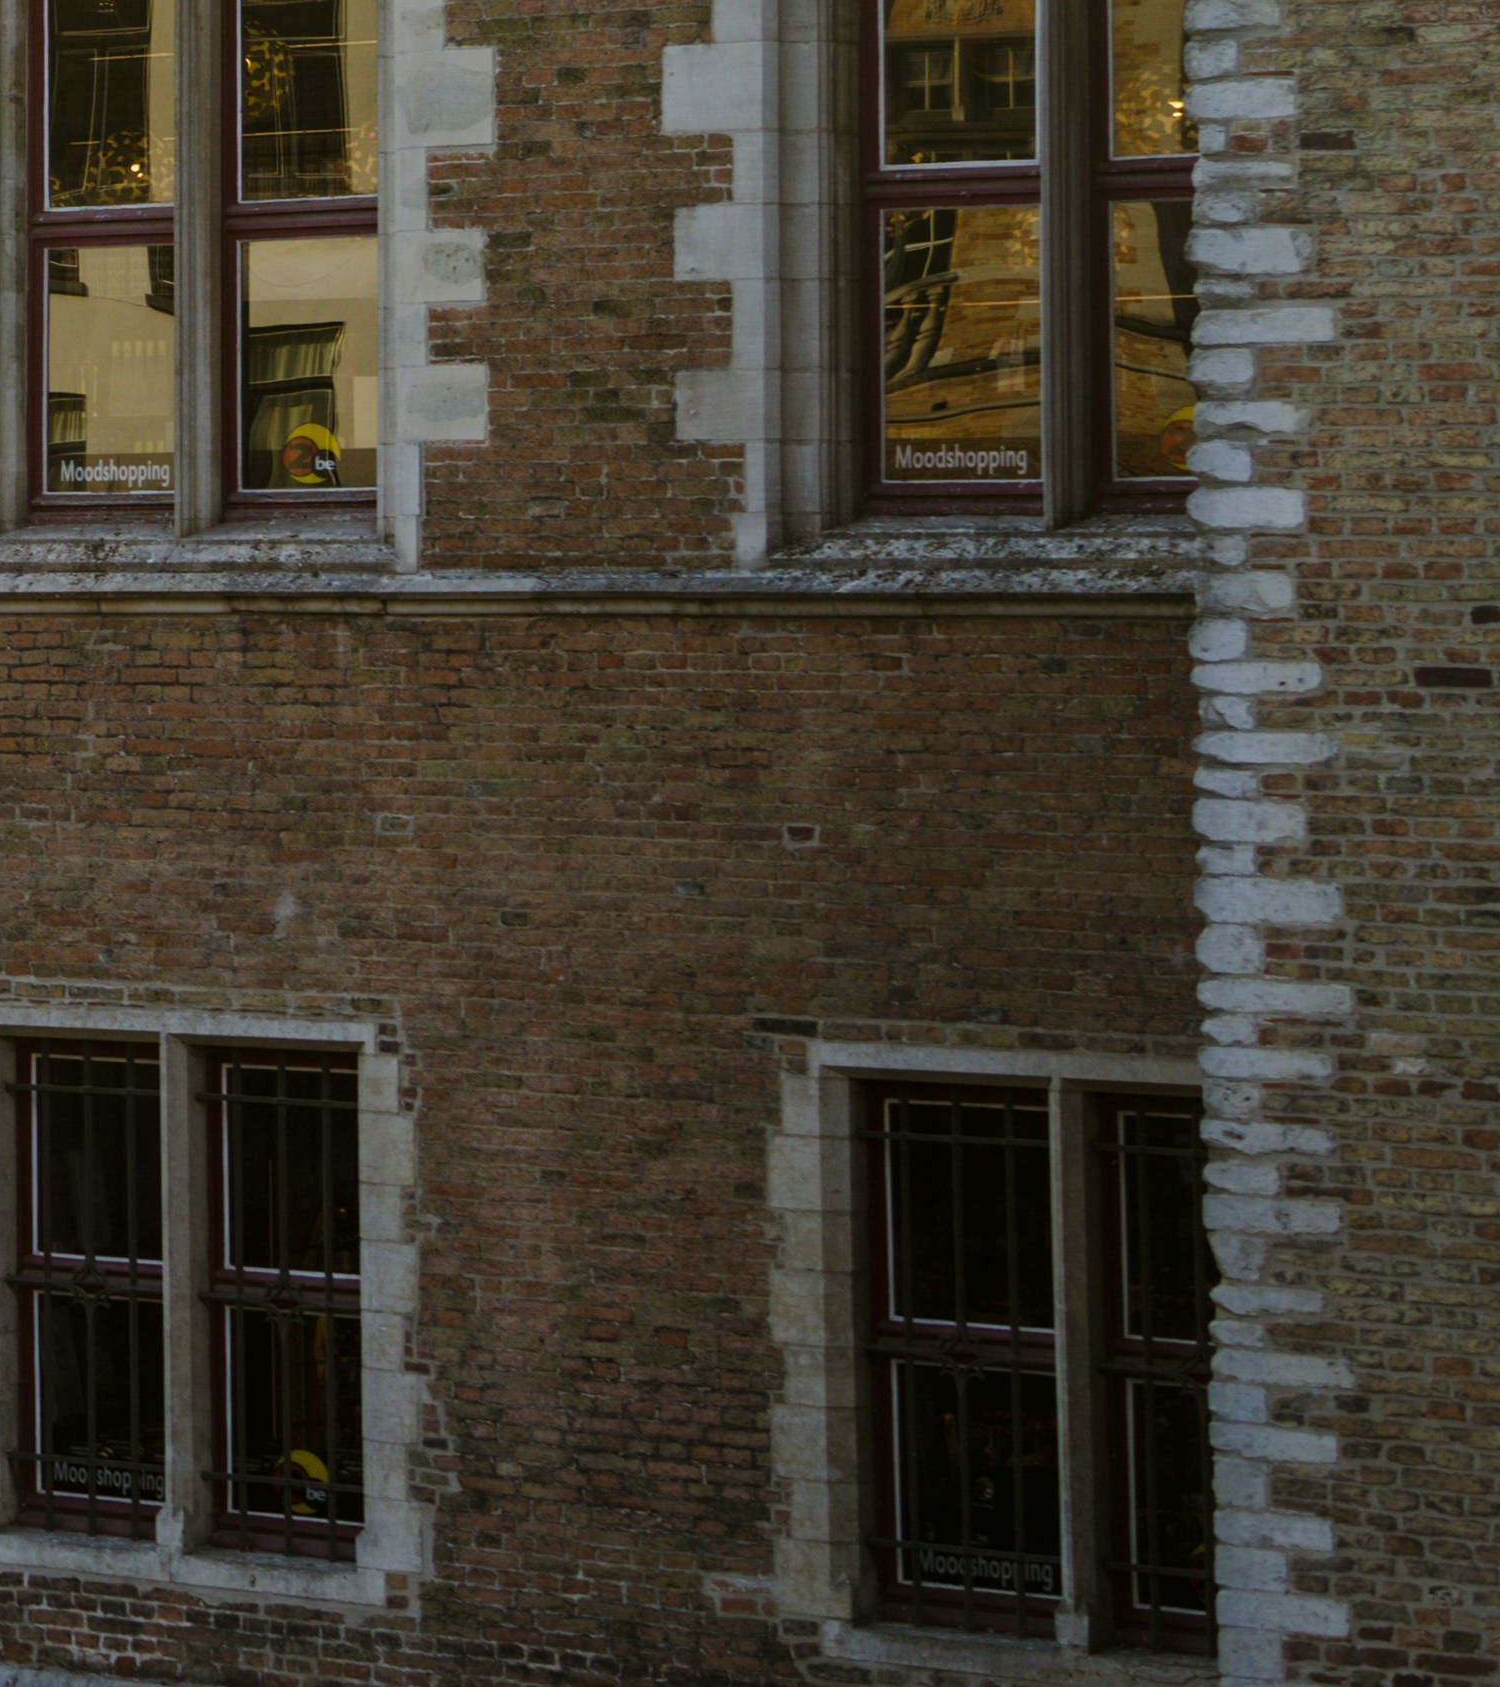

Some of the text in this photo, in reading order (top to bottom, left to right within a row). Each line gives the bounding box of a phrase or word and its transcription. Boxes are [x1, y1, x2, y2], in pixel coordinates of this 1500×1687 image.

[60, 458, 170, 488] Moodshopping
[895, 443, 1028, 475] Moodshopping
[53, 1461, 165, 1499] Mooshoping
